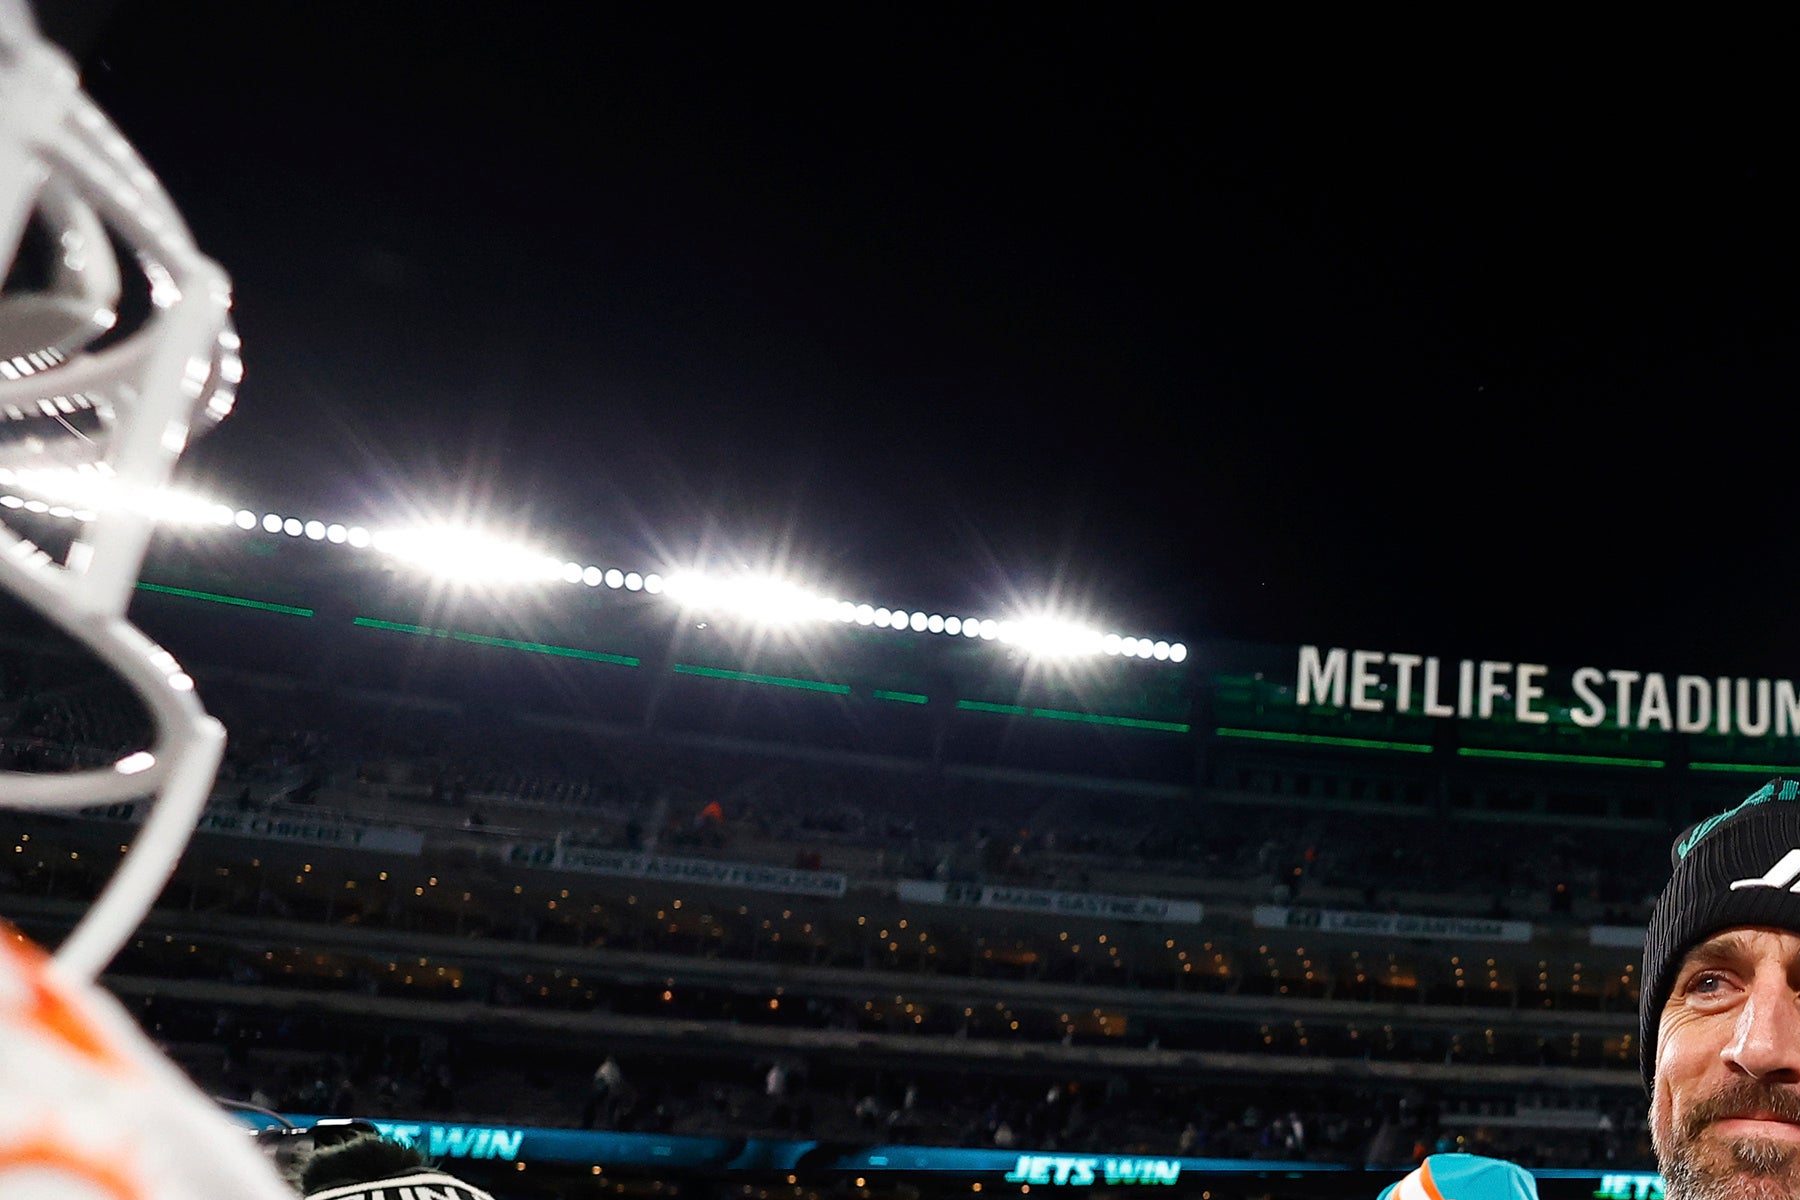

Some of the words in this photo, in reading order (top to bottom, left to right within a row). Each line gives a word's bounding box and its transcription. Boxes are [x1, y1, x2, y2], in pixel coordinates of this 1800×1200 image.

[1296, 645, 1549, 725] METLIFE
[428, 1125, 524, 1161] WIN
[1004, 1155, 1098, 1186] JETS
[1104, 1158, 1182, 1186] WIN
